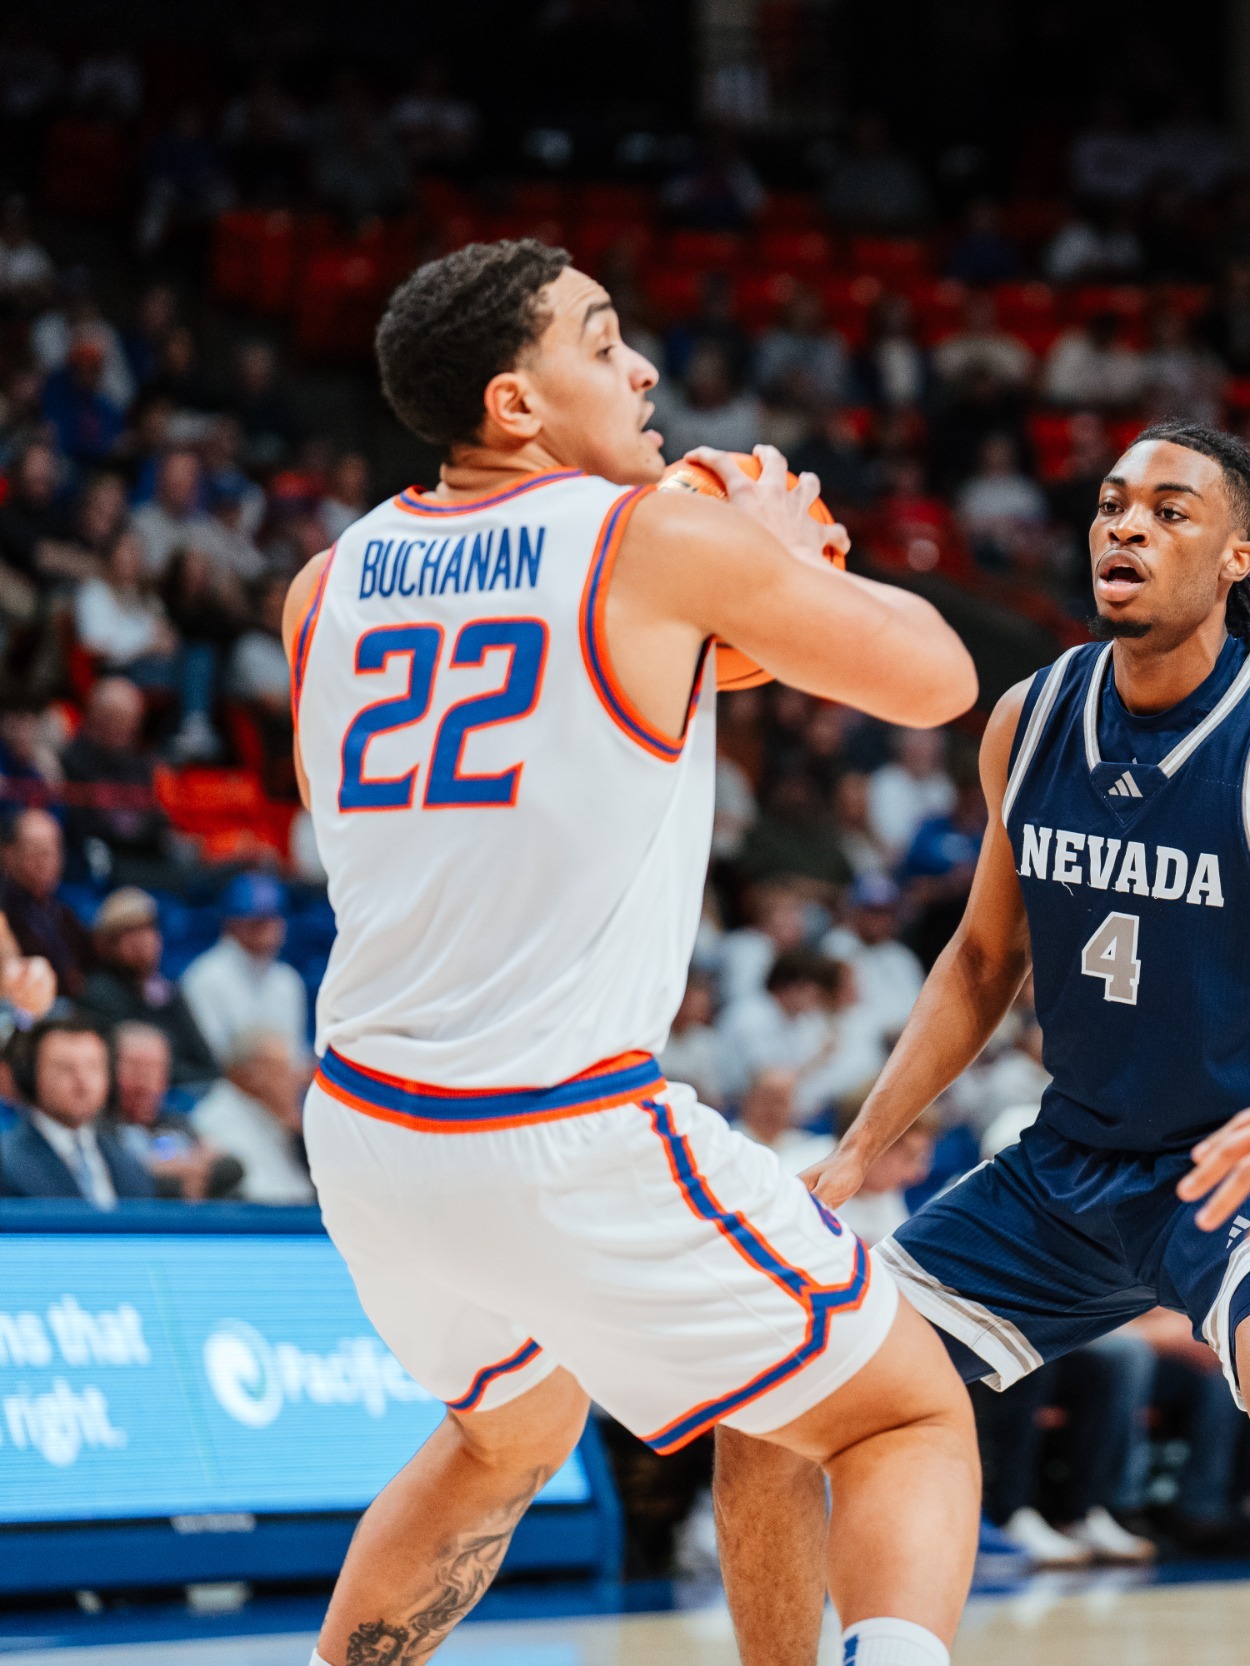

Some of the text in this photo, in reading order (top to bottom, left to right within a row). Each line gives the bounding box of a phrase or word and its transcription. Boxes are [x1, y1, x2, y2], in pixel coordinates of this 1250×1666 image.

[359, 526, 545, 600] BUCHANAN
[337, 616, 550, 814] 22
[1020, 823, 1225, 908] NEVADA
[1081, 911, 1141, 1006] 4
[47, 1293, 151, 1367] that
